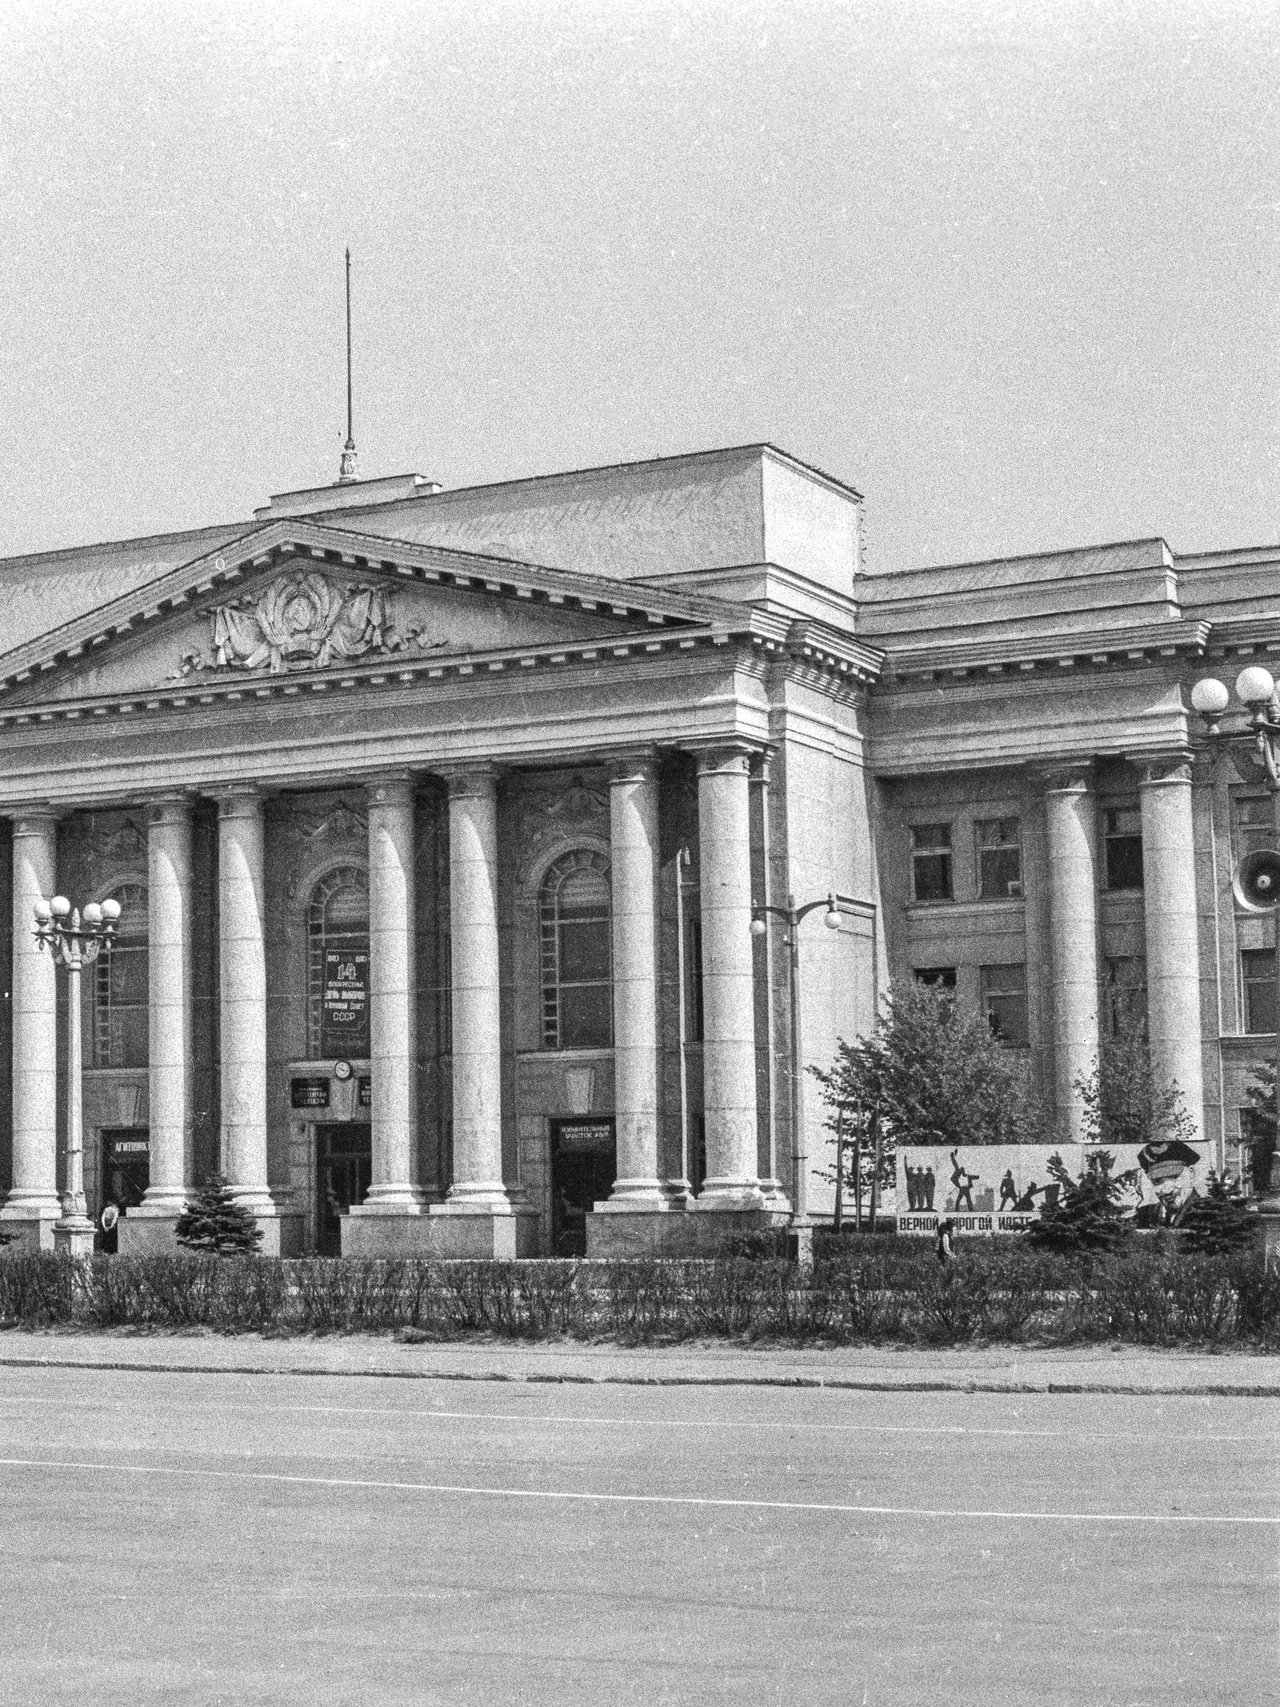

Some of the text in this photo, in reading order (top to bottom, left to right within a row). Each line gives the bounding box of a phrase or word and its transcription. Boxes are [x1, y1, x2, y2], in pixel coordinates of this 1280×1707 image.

[338, 963, 357, 980] 14
[333, 1011, 356, 1021] СССР
[115, 1141, 150, 1152] АГИТПУНК
[899, 1215, 939, 1231] ВЕРНОЙ
